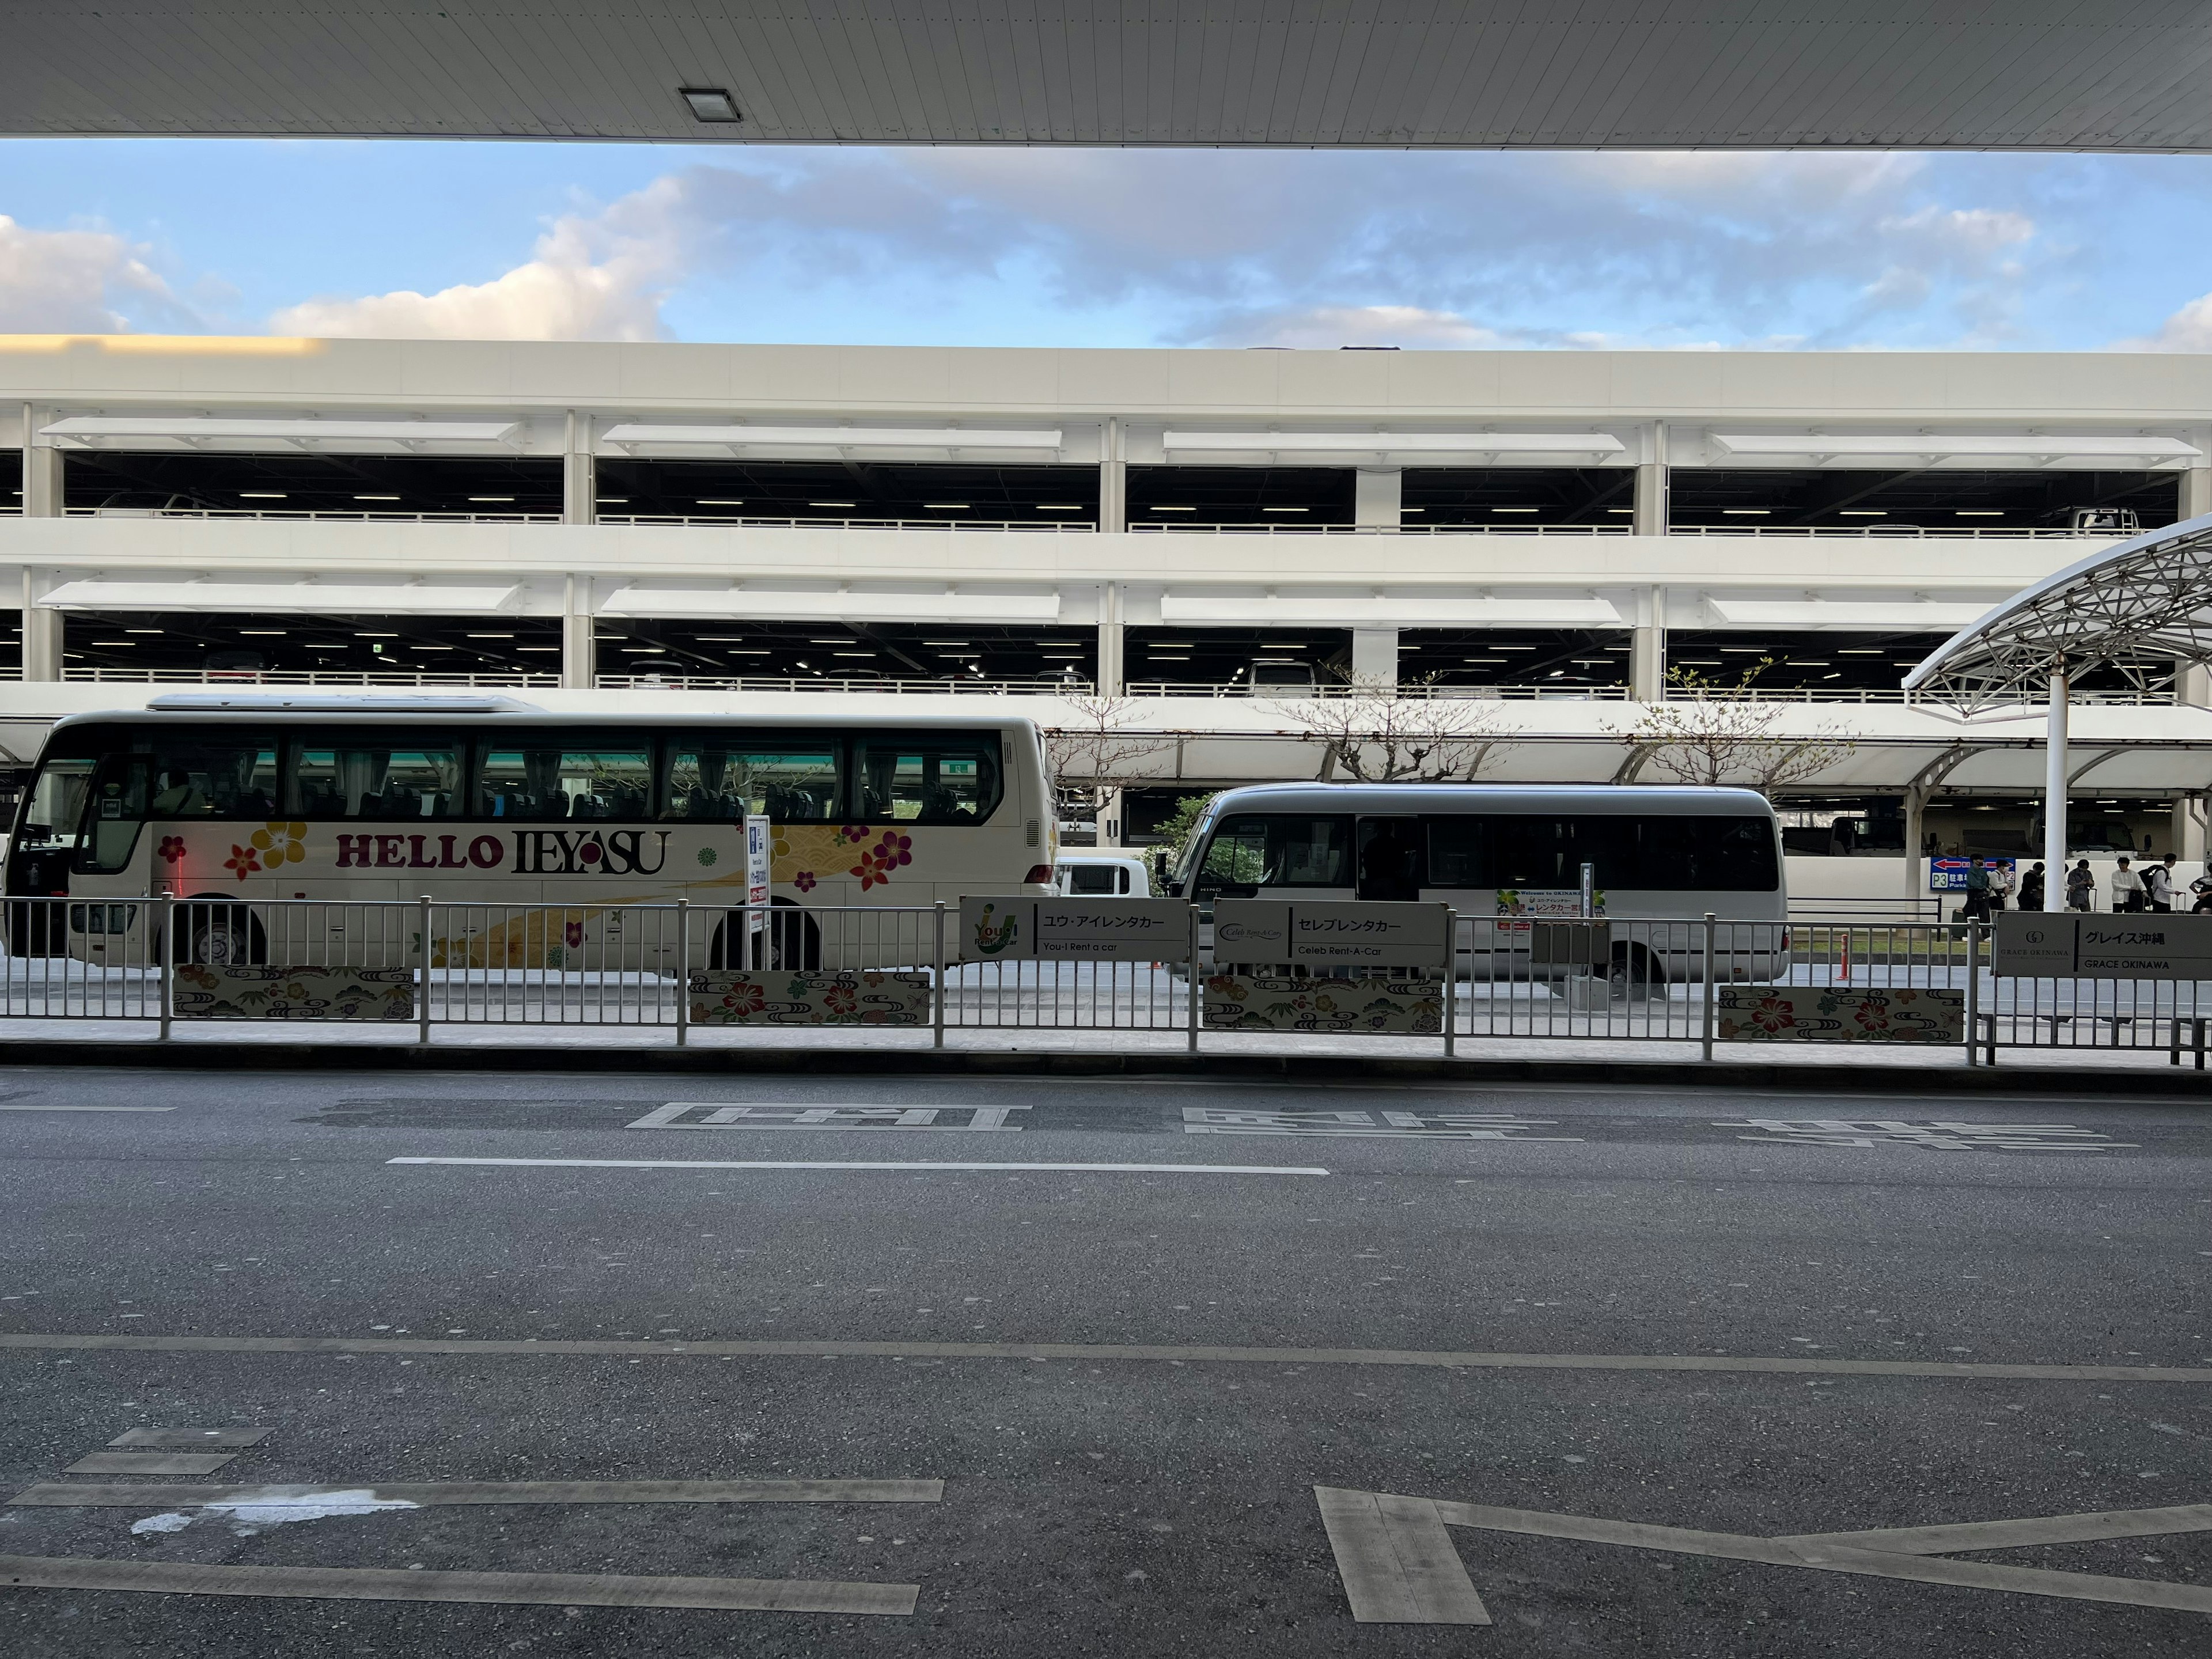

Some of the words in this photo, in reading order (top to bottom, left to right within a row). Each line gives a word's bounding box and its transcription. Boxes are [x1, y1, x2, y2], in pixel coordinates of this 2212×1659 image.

[335, 834, 504, 869] HELLO
[511, 830, 672, 875] IEYASU
[1933, 874, 1946, 886] P3
[1043, 915, 1164, 929] ユウ・アイレンタカー
[1298, 918, 1401, 932] セレブレンタカー
[2085, 932, 2165, 945] グレイス沖縄
[1043, 942, 1067, 951] You-I
[1070, 943, 1090, 952] Rent
[1298, 946, 1327, 955] Celeb
[1330, 947, 1381, 956] Rent-A-Car
[2084, 960, 2118, 968] GRACE
[2122, 960, 2169, 969] OKINAWA
